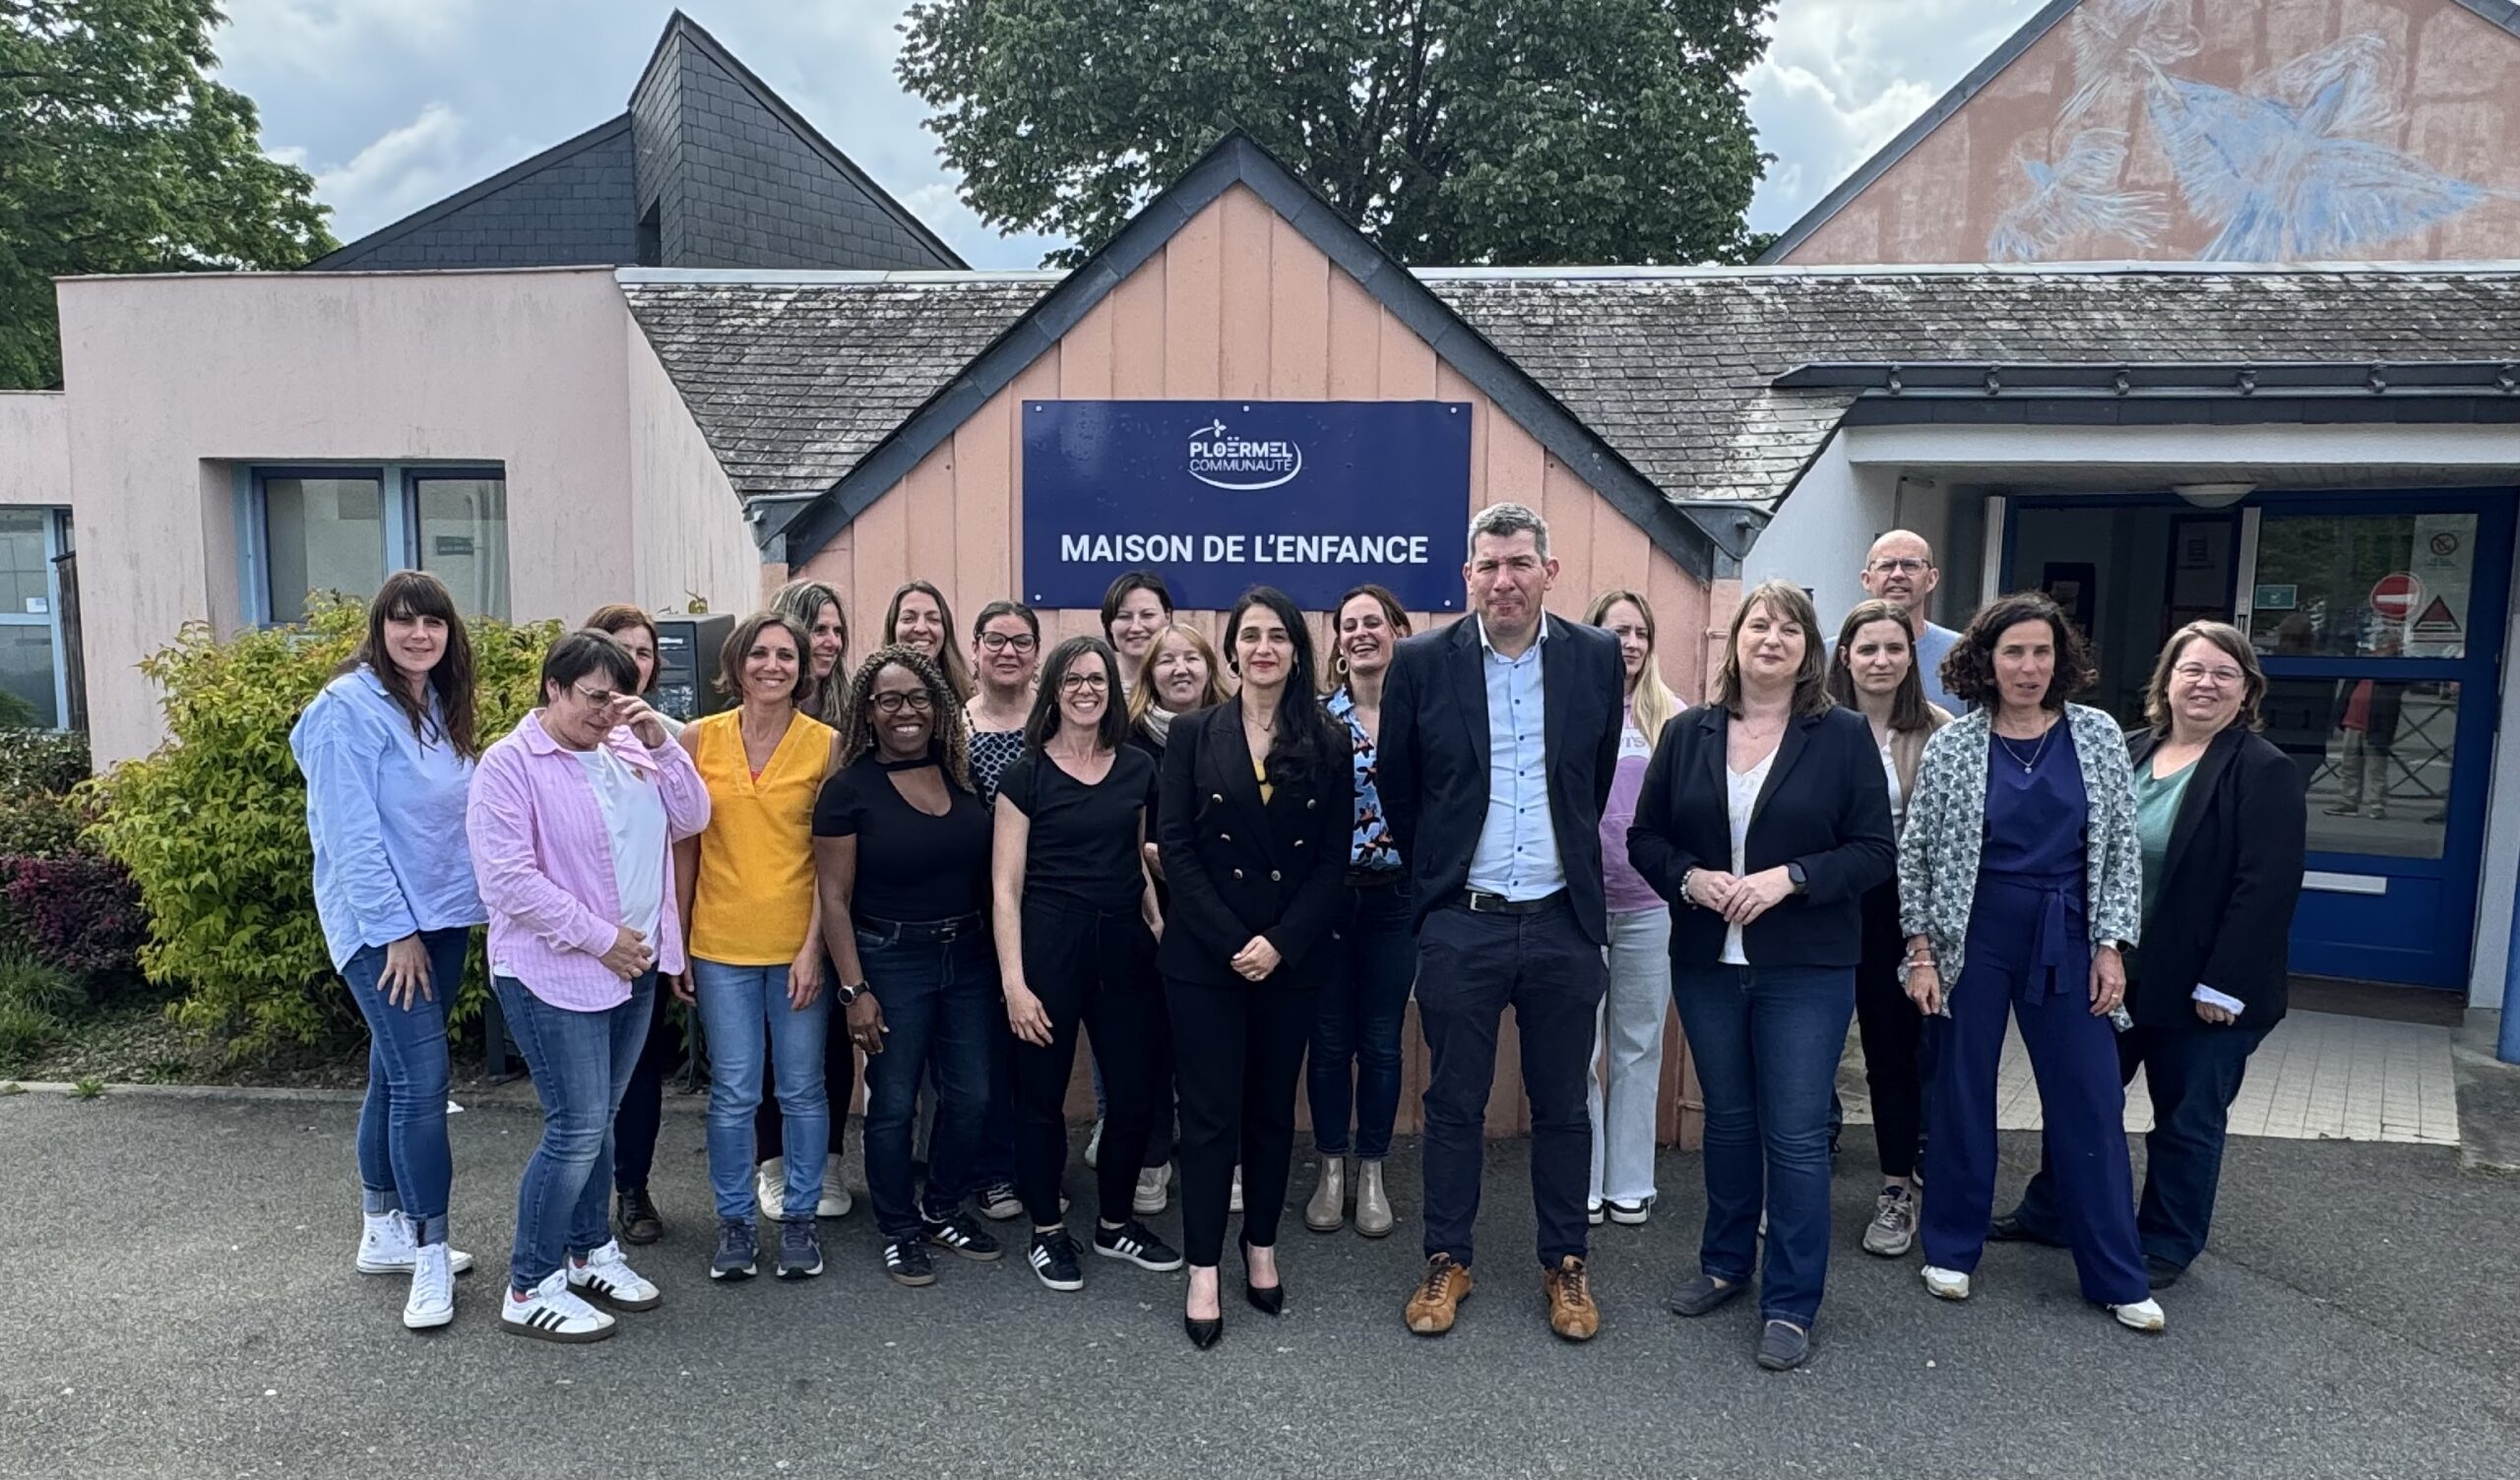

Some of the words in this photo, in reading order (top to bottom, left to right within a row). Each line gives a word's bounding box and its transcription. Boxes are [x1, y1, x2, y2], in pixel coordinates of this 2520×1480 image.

[1189, 436, 1293, 458] PLOËRMEL
[1189, 458, 1293, 472] COMMUNAUTÉ
[1061, 534, 1193, 563] MAISON
[1204, 534, 1246, 563] DE
[1254, 534, 1429, 564] L’ENFANCE
